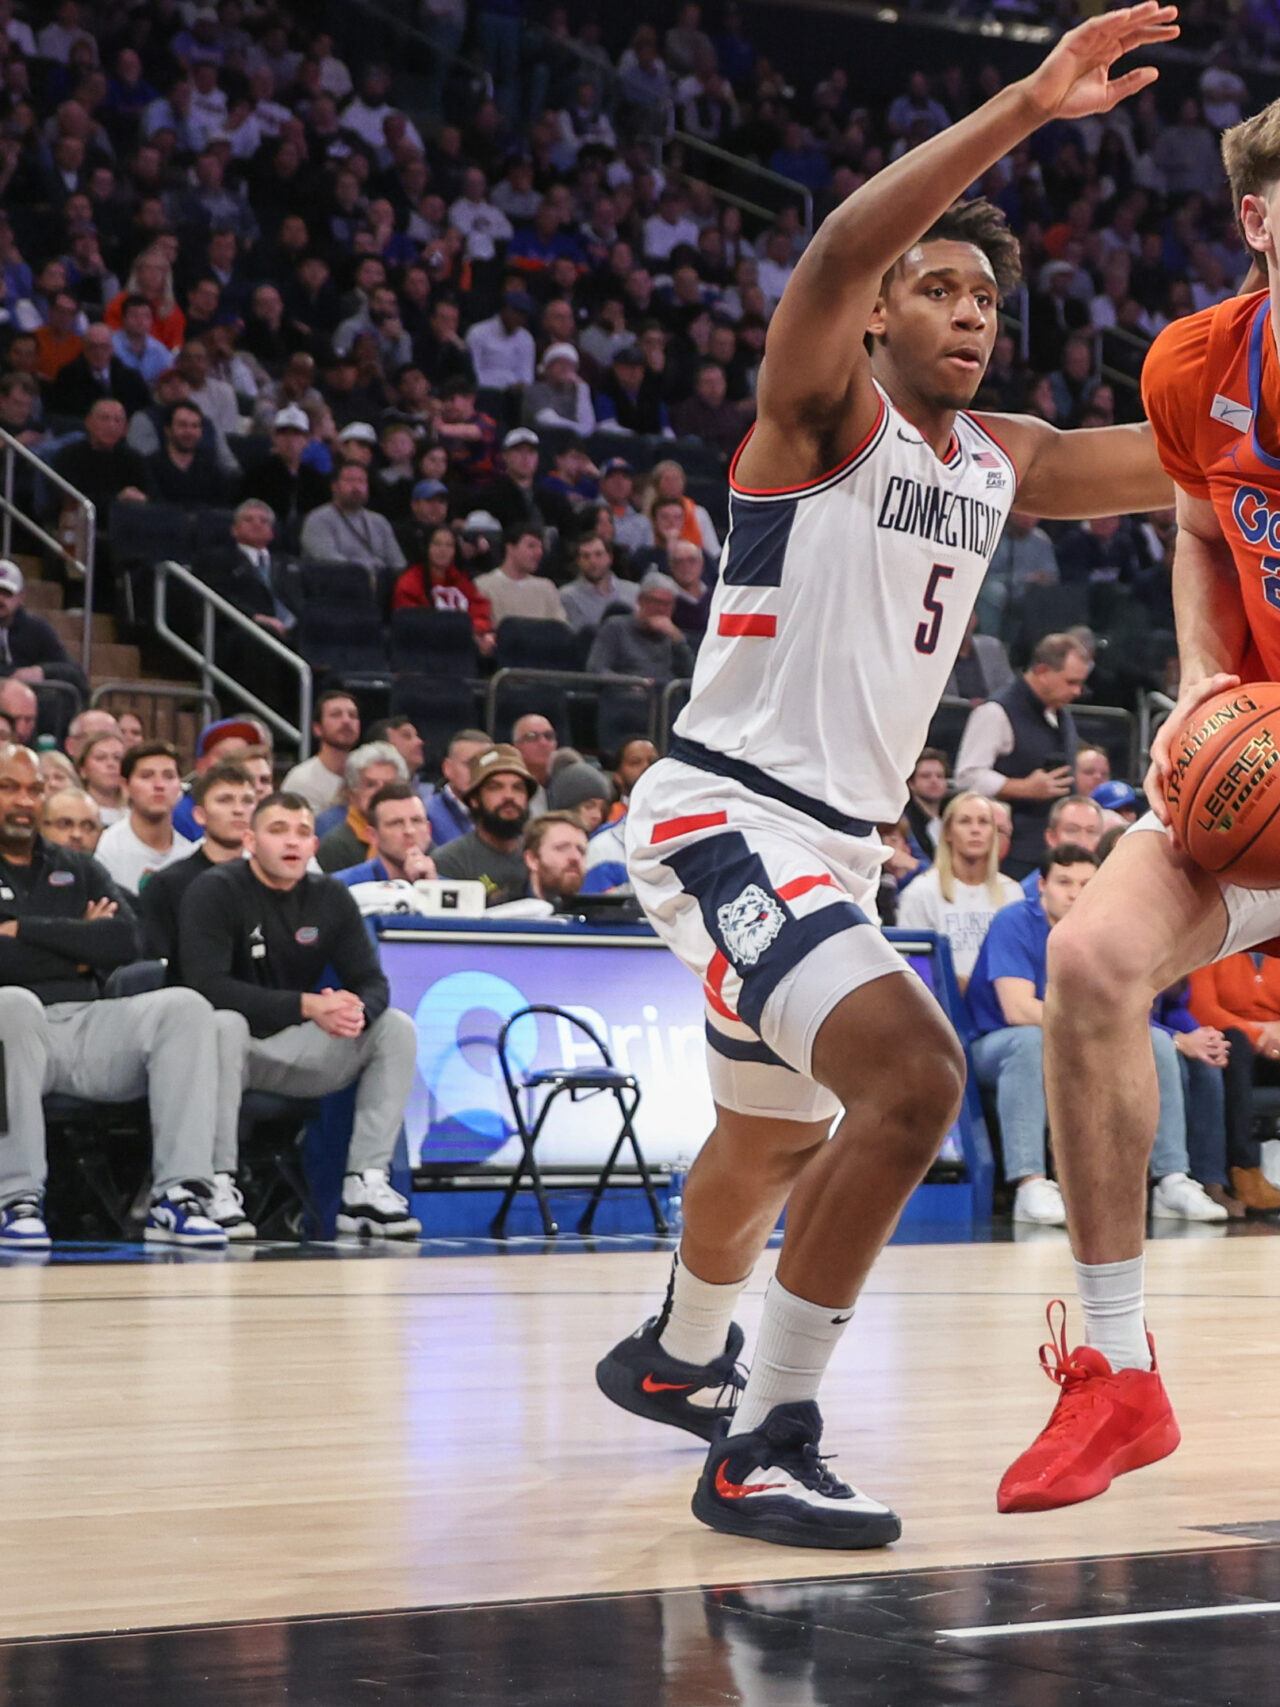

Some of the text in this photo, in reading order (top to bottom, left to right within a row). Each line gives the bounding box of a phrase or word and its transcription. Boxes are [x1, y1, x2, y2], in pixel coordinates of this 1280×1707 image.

[877, 475, 1002, 563] CONNECTICUT
[986, 479, 1006, 487] EAST
[914, 563, 955, 656] 5
[1167, 694, 1258, 813] SPALDING
[1196, 728, 1275, 832] LEGACY
